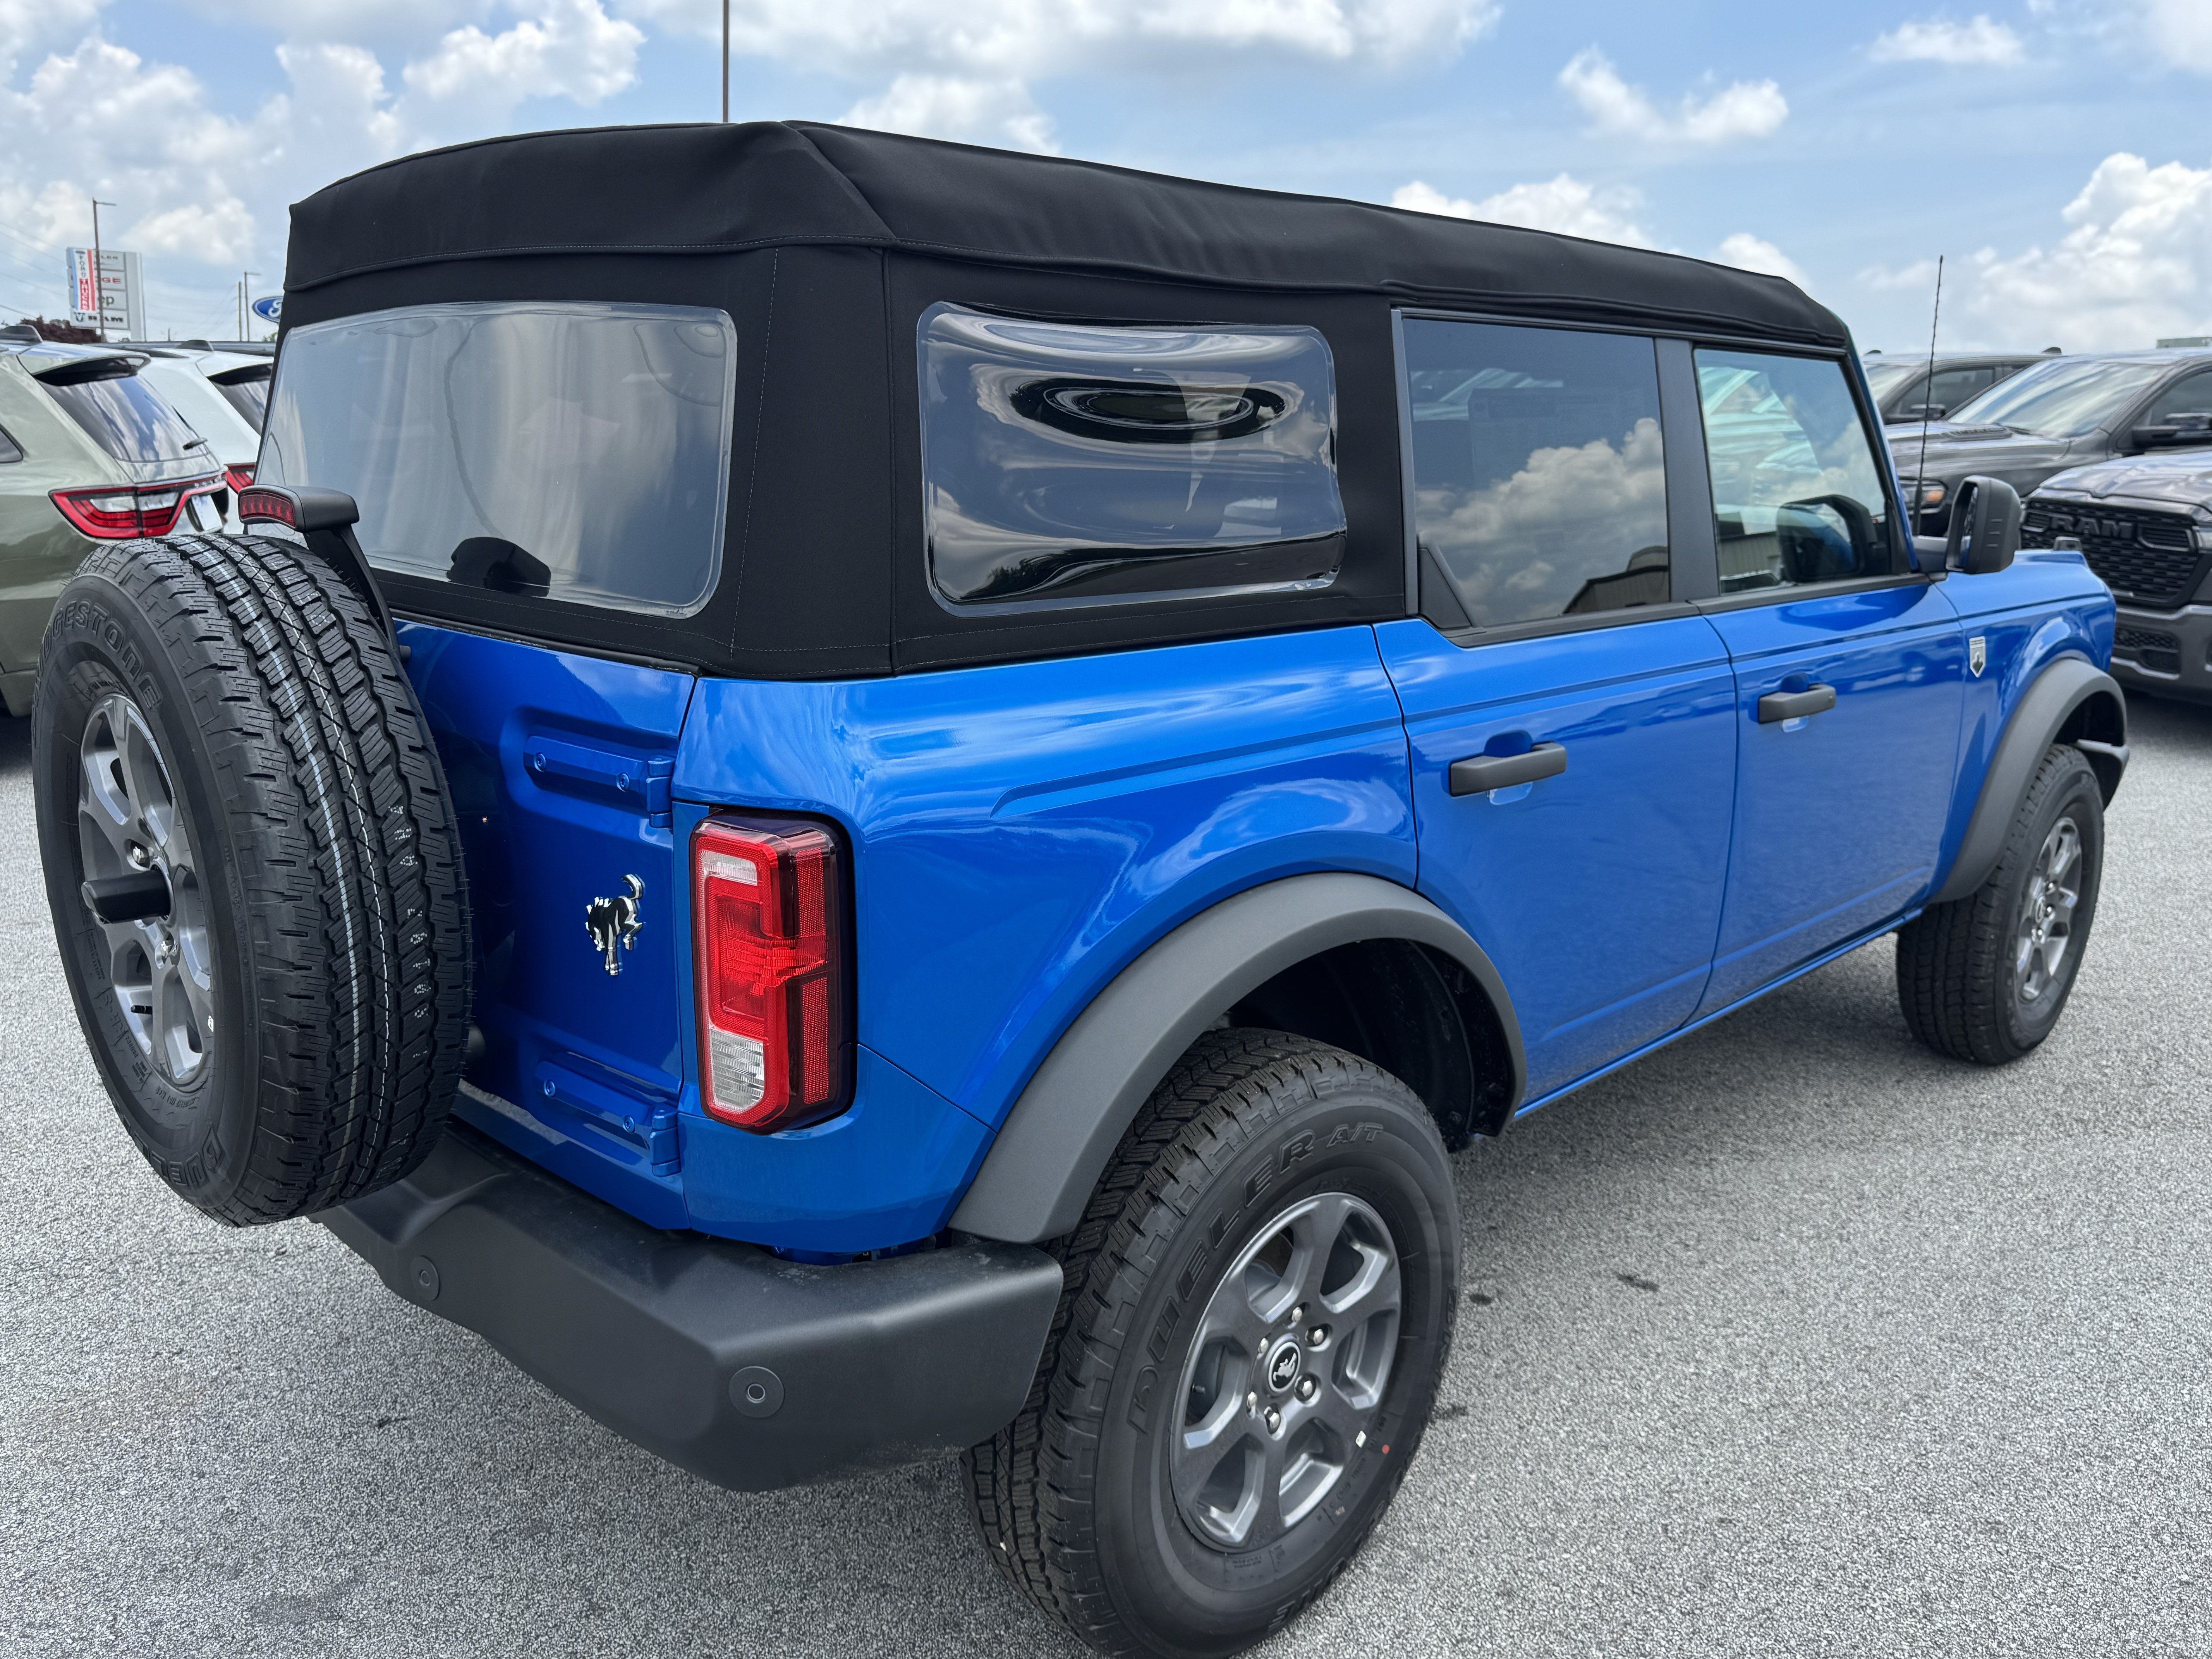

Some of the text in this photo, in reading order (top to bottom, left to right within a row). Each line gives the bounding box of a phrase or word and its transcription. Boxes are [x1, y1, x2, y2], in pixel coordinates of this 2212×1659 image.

[2052, 513, 2133, 539] RAM
[1127, 1129, 1316, 1434] DUELER
[1326, 1121, 1385, 1148] A/T
